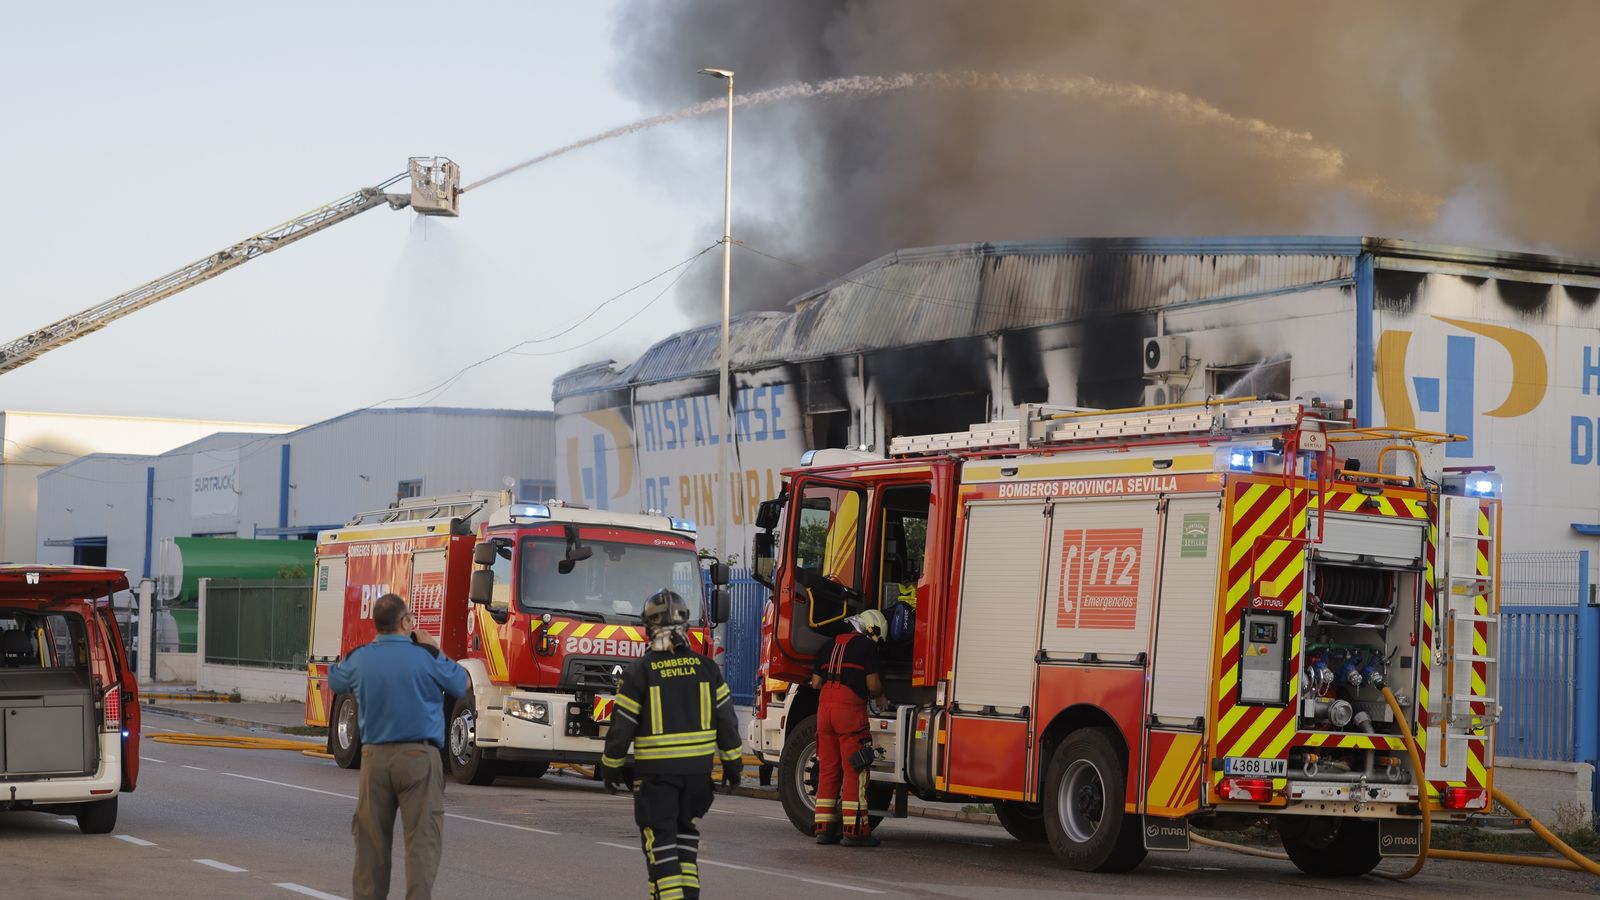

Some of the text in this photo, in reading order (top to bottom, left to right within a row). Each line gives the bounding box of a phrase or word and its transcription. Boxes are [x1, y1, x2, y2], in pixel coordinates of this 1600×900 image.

[642, 385, 786, 451] HISPALNSE
[999, 476, 1177, 498] BOMBEROS PROVINCIA SEVILLA
[1088, 547, 1136, 585] 112
[422, 584, 441, 609] 112
[1084, 595, 1134, 610] Emergencias
[651, 657, 701, 670] BOMBEROS
[660, 667, 696, 678] SEVILLA
[1232, 760, 1284, 774] 4368 LMW
